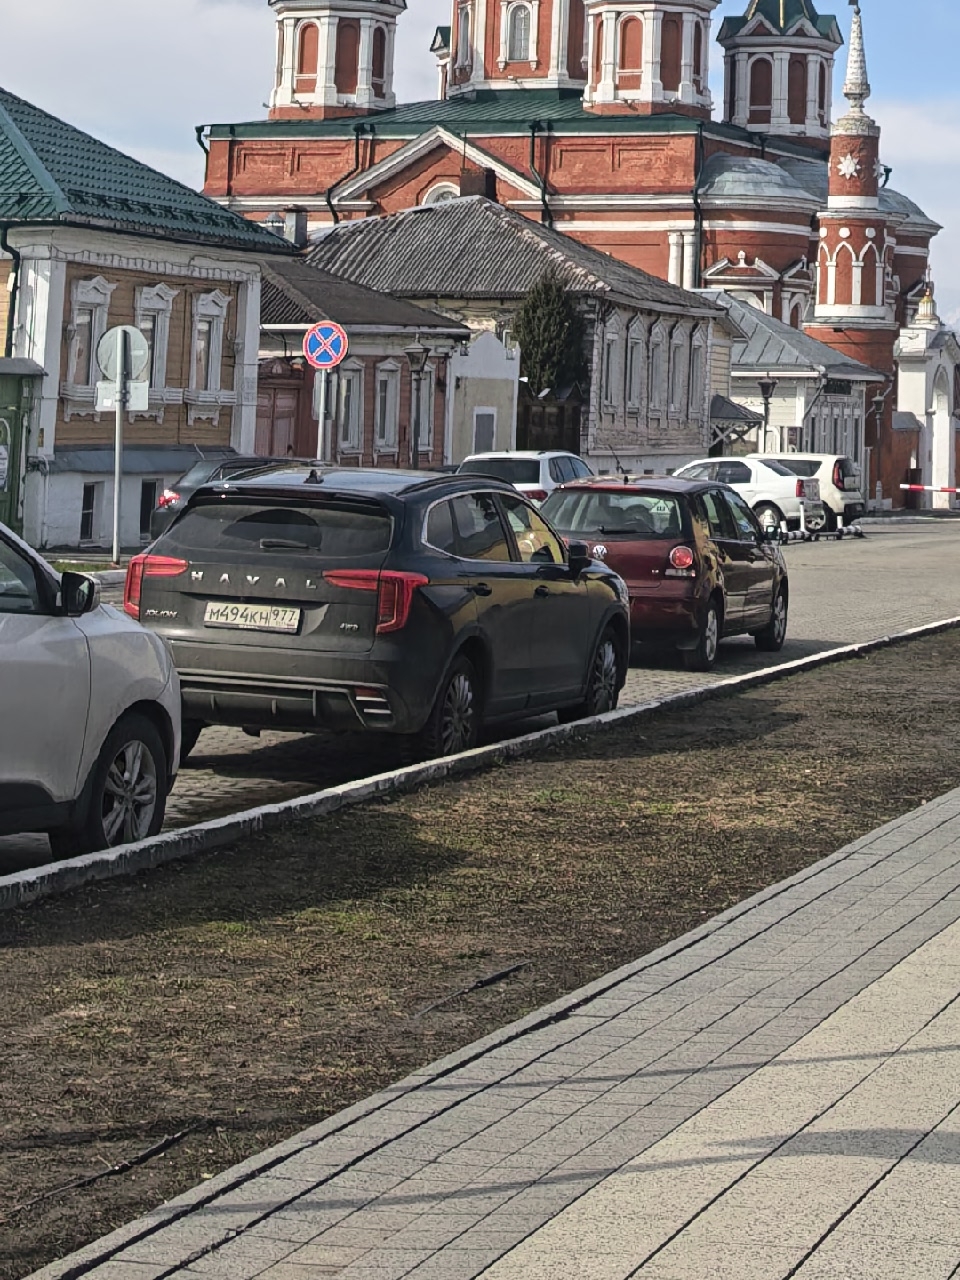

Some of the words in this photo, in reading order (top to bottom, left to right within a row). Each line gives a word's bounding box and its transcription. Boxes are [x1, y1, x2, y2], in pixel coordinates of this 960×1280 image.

[191, 571, 316, 588] HAVAL
[209, 604, 269, 624] М494КН
[272, 607, 296, 621] 977
